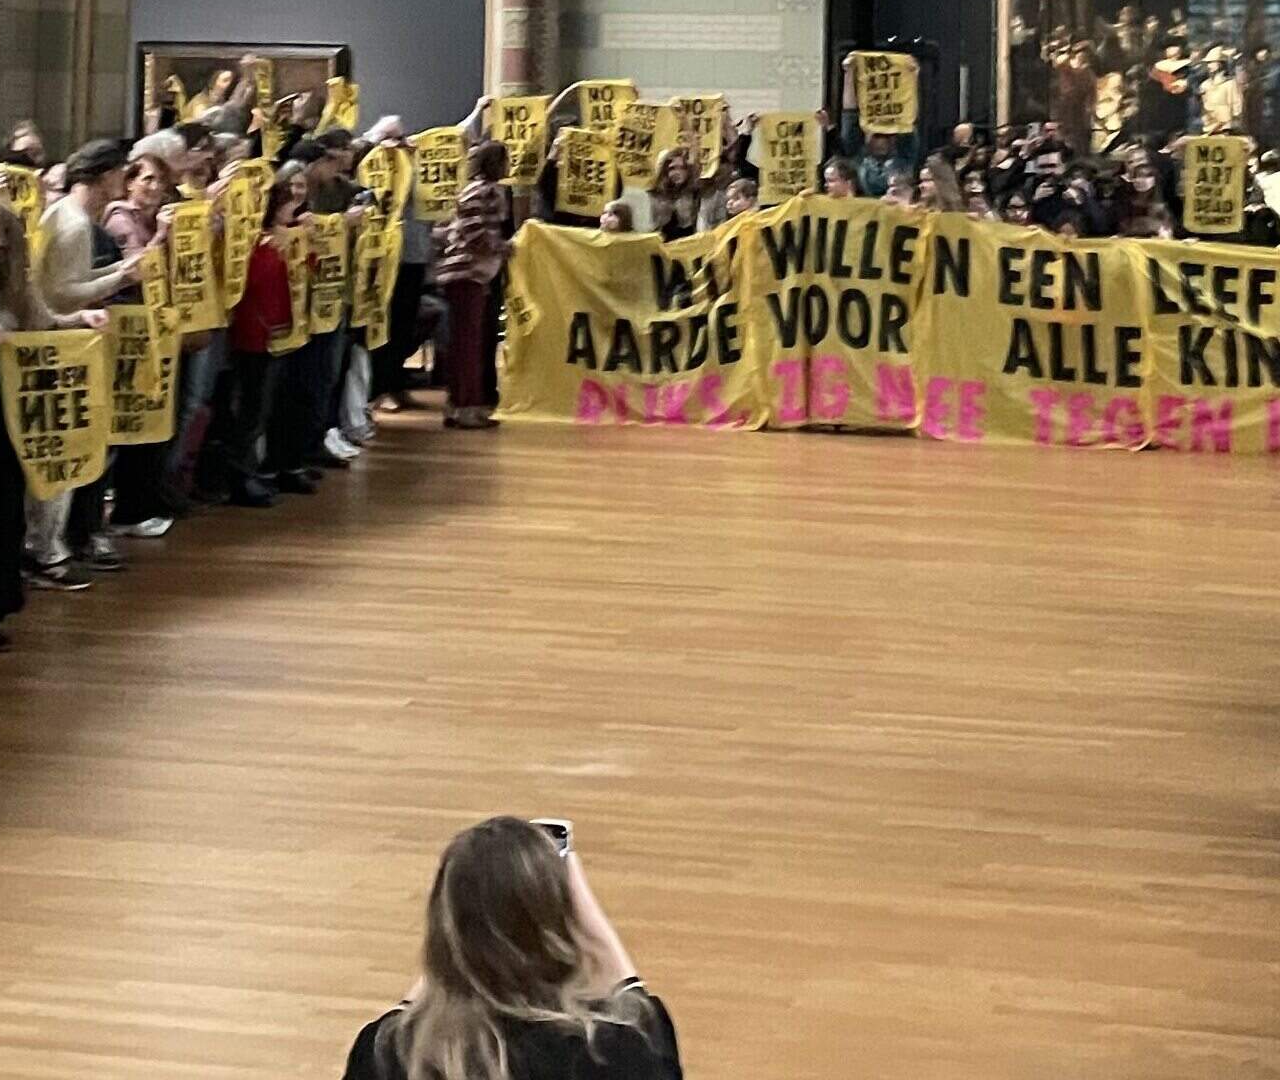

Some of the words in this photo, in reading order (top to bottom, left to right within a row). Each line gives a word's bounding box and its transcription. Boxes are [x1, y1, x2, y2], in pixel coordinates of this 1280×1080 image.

[865, 56, 891, 73] NO
[866, 71, 901, 92] ART
[588, 86, 614, 102] NO
[504, 106, 528, 122] NO
[590, 104, 614, 121] AR
[504, 123, 538, 140] ART
[1196, 146, 1225, 164] NO
[567, 159, 606, 183] NEE
[1195, 166, 1233, 185] ART
[761, 216, 971, 298] WILLEN
[997, 246, 1103, 312] EEN
[566, 302, 742, 375] AARDE
[766, 284, 909, 354] VOOR
[1002, 318, 1142, 388] ALLE
[875, 362, 987, 442] NEE
[1029, 387, 1234, 454] TEGEN
